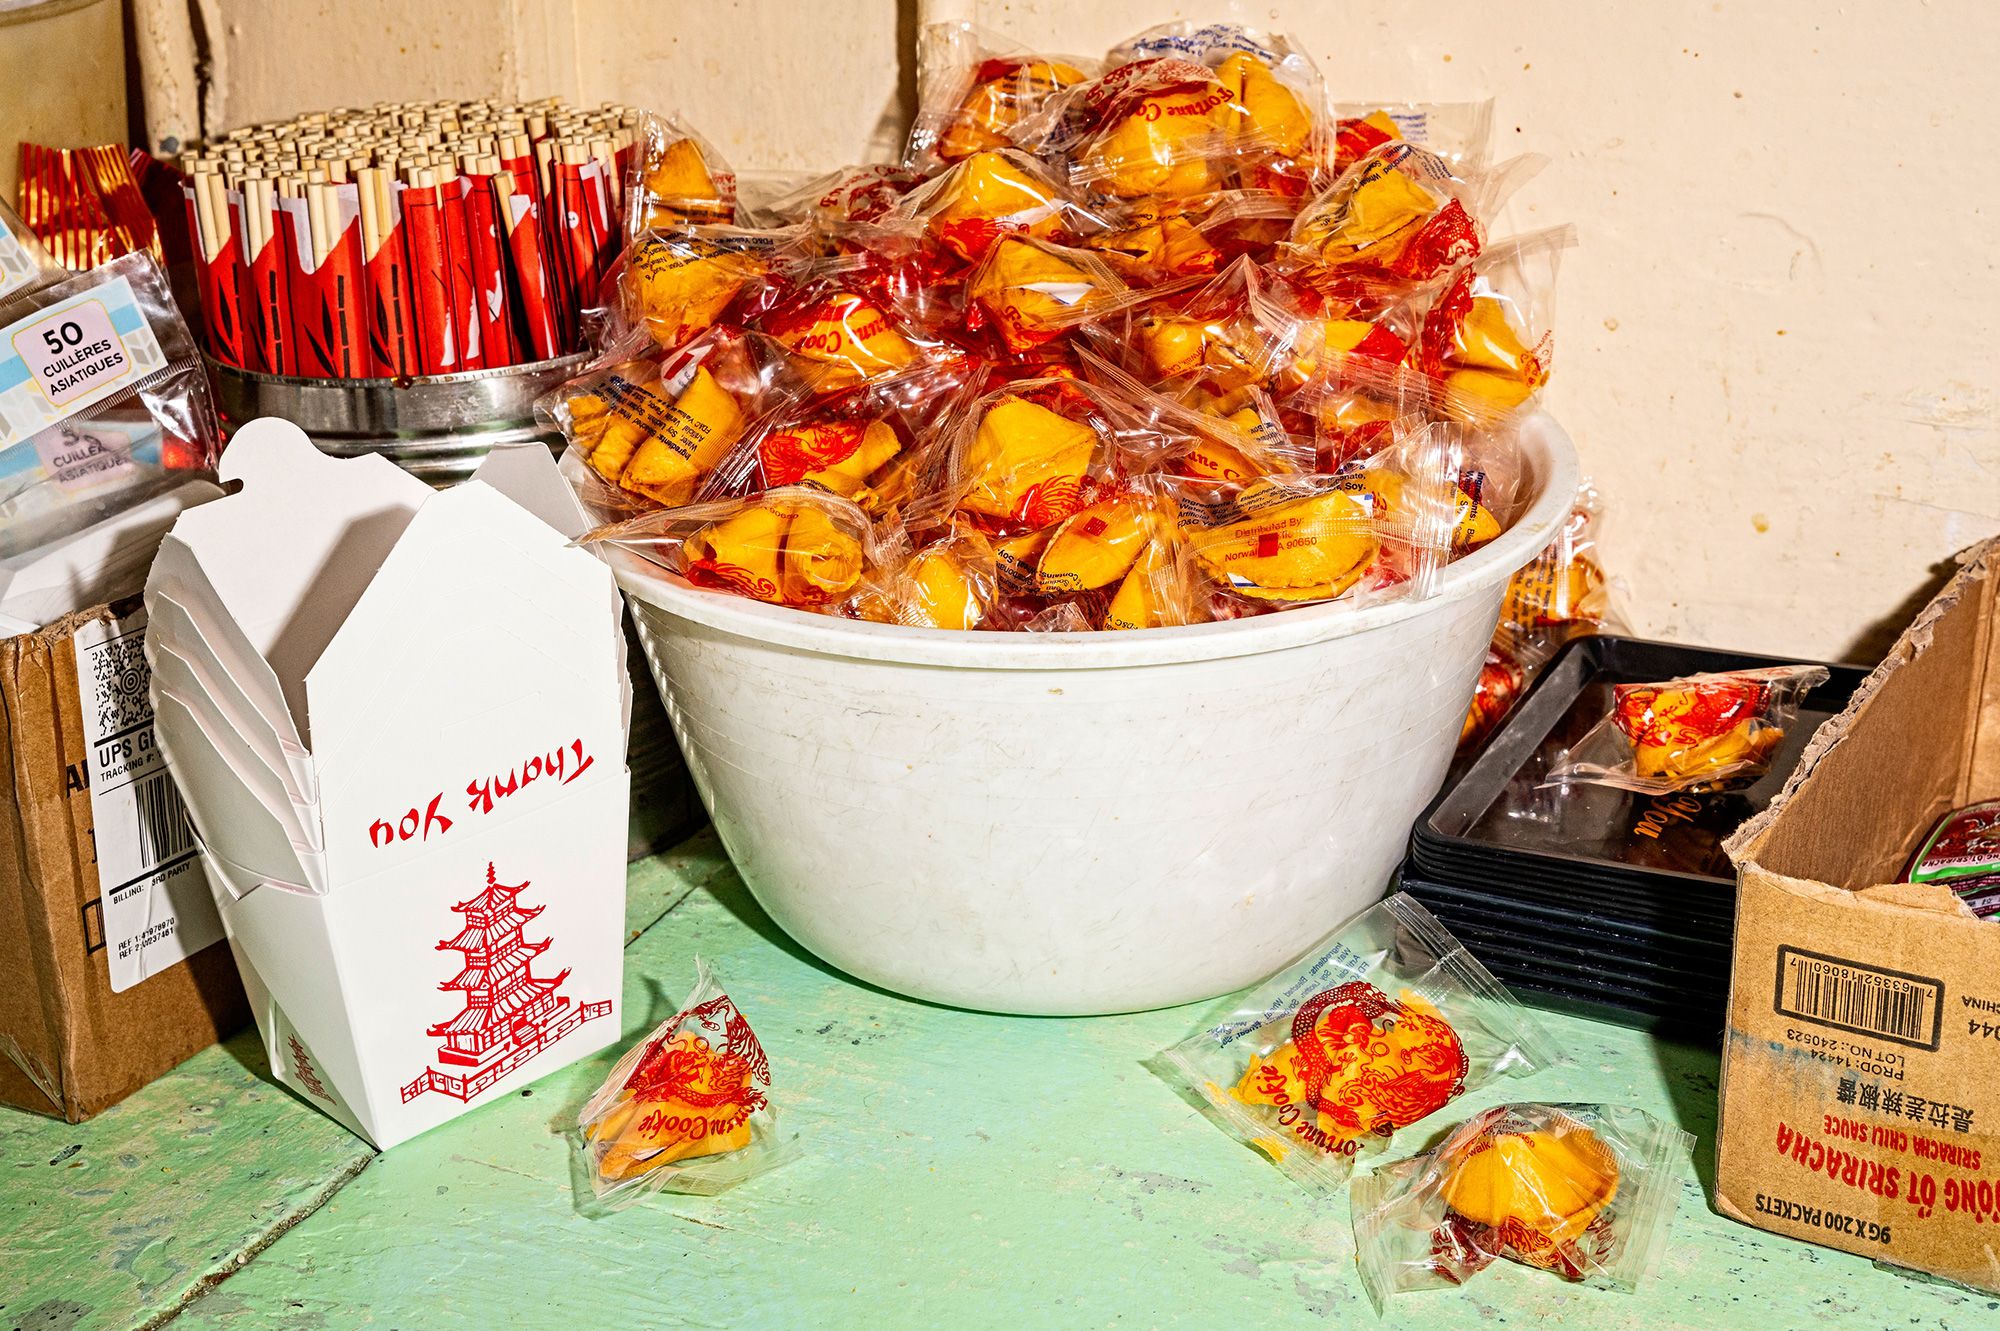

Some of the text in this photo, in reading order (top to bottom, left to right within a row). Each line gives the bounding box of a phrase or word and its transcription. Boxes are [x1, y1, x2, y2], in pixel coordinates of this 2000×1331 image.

[43, 321, 83, 355] 50
[43, 339, 112, 378] CUILLÈRES
[50, 353, 124, 396] ASIATIQUES
[655, 433, 691, 461] Ingredients:
[1344, 481, 1366, 492] Soy.
[1235, 521, 1287, 539] Distributed
[1225, 547, 1259, 562] Norwal
[1286, 537, 1317, 550] 90650
[99, 741, 133, 768] UPS
[100, 758, 143, 783] TRACKING
[466, 738, 594, 815] Thank
[113, 884, 144, 905] BILLING:
[167, 861, 191, 880] PARTY
[118, 938, 133, 951] REF
[118, 947, 133, 960] REF
[1813, 959, 1859, 982] 18060
[1864, 972, 1910, 993] 63352
[1786, 1029, 1838, 1053] 240523
[1855, 1061, 1905, 1080] PROD:
[1877, 1050, 1905, 1067] LOT
[1257, 1064, 1301, 1127] Cookie
[637, 1109, 709, 1140] Cookie
[1823, 1114, 1981, 1171] SRIRACHA CHILI SAUCE
[1776, 1120, 1901, 1200] SRIRACHA
[1755, 1193, 1822, 1226] PACKETS
